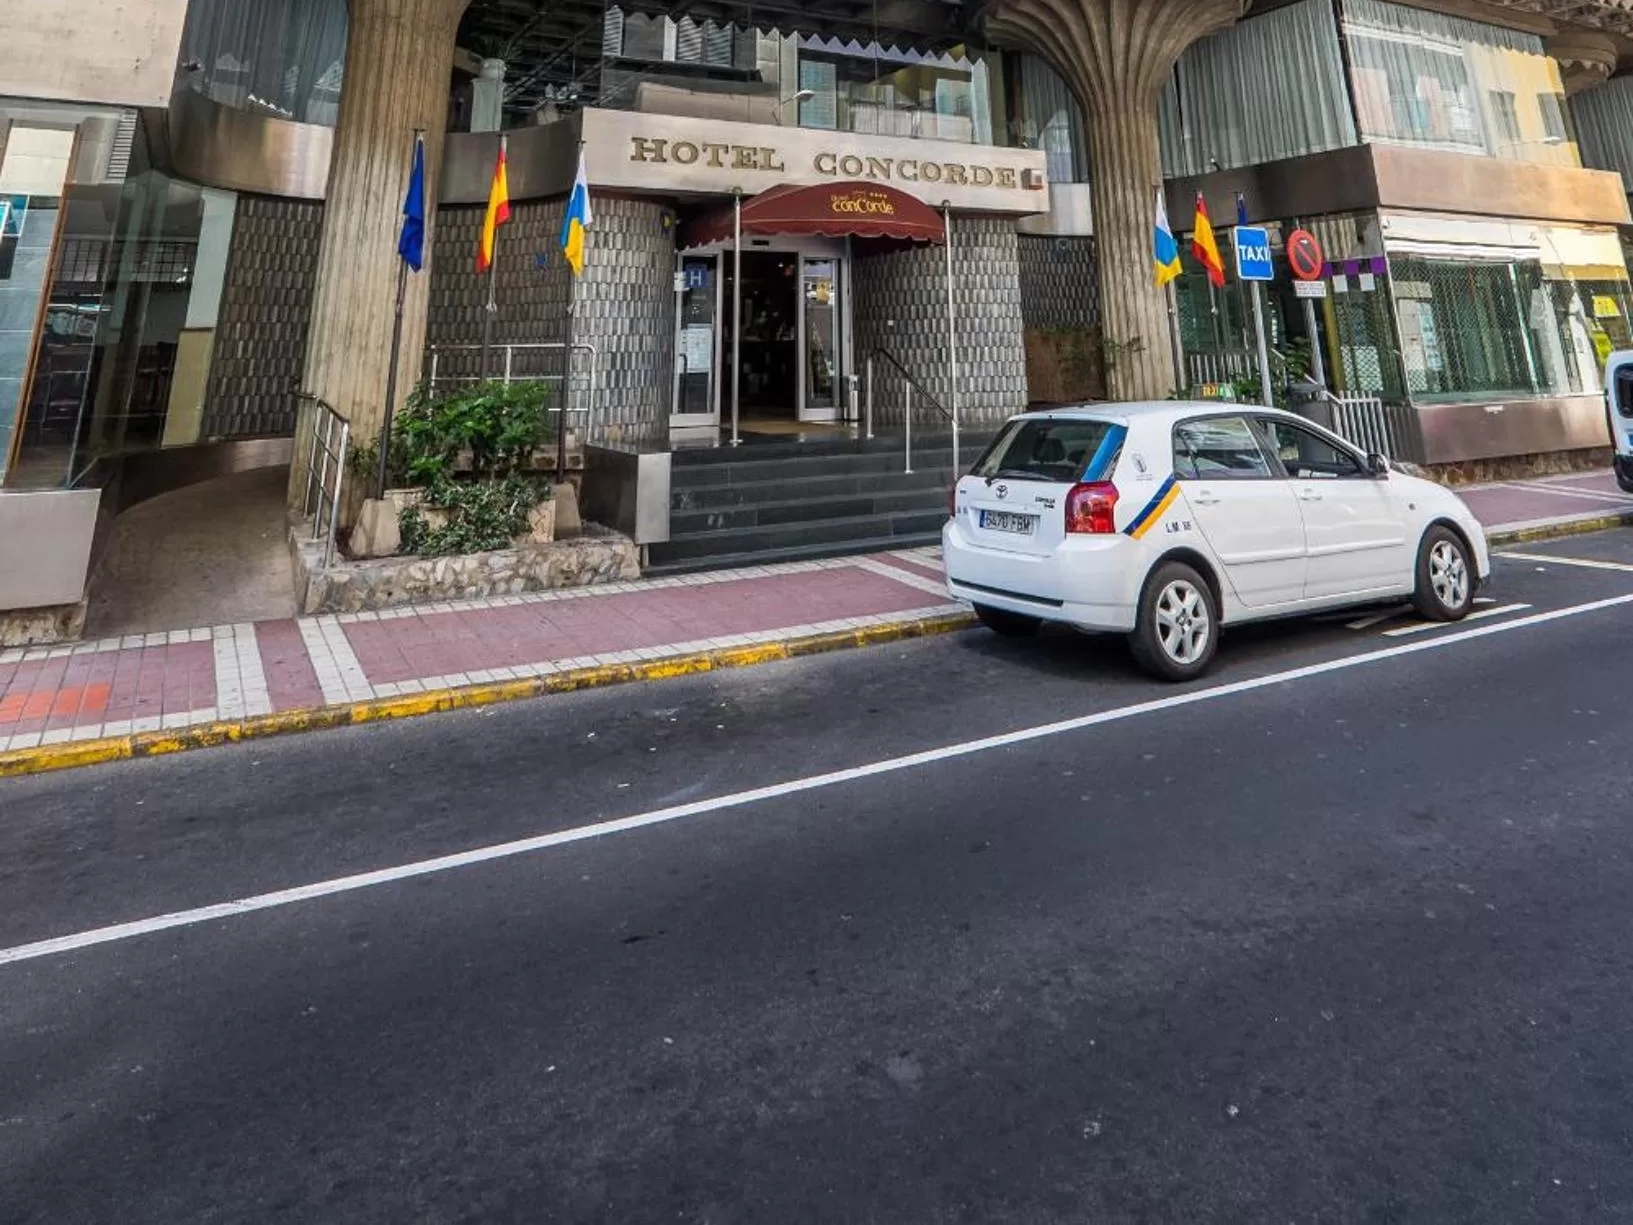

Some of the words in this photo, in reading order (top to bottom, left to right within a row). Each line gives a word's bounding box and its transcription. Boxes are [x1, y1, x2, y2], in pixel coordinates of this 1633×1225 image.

[630, 136, 785, 173] HOTEL
[813, 152, 1017, 190] CONCORDE
[1239, 244, 1268, 262] TAXI
[690, 270, 702, 286] H
